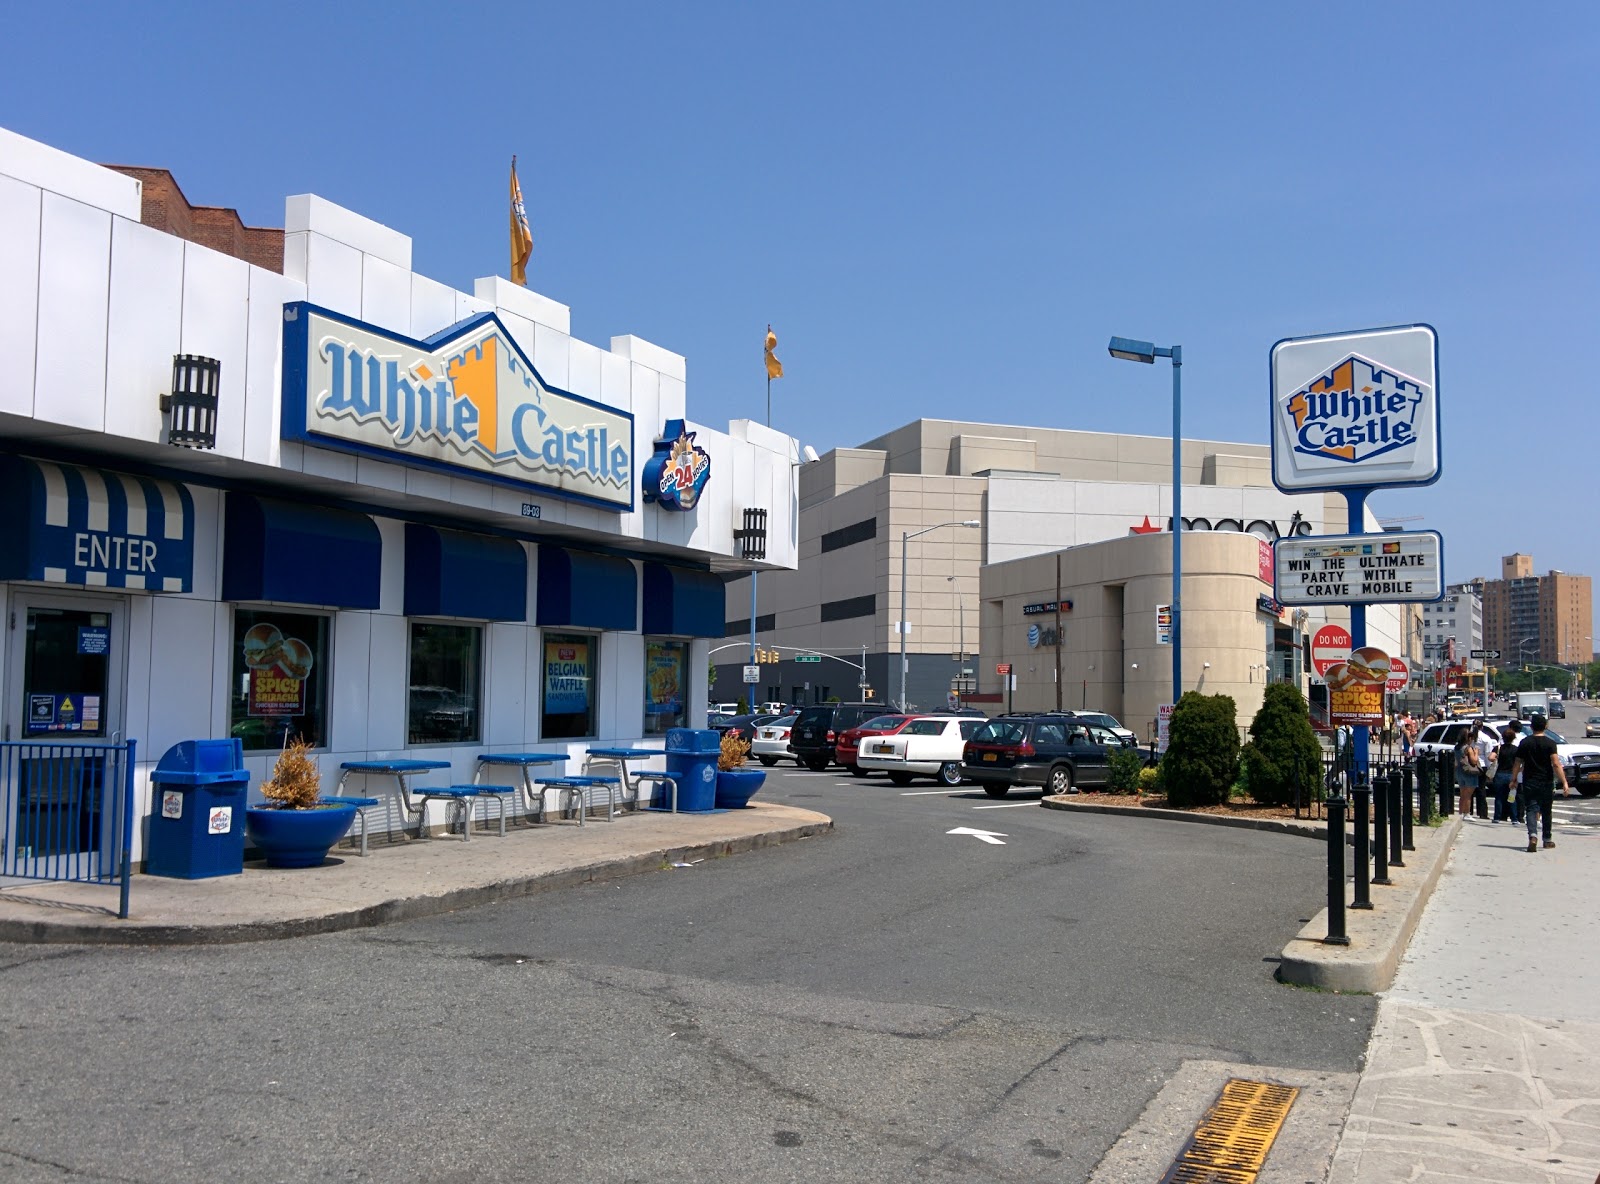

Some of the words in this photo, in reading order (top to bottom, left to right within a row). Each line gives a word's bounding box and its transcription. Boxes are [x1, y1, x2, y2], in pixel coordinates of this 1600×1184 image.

[322, 342, 479, 443] White
[511, 403, 629, 483] Castle
[1304, 390, 1407, 422] White
[1298, 416, 1412, 449] Castle
[660, 472, 675, 491] OPEN
[674, 464, 694, 488] 24
[692, 455, 708, 480] HOURS
[523, 504, 540, 518] 89-03
[75, 533, 157, 573] ENTER
[1288, 560, 1311, 571] WIN
[1322, 558, 1345, 569] THE
[1359, 554, 1425, 568] ULTIMATE
[1301, 571, 1344, 583] PARTY
[1364, 569, 1396, 581] WITH
[1306, 584, 1349, 596] CRAVE
[1362, 582, 1413, 594] MOBILE
[1319, 635, 1330, 645] DO
[1332, 635, 1348, 645] NOT
[256, 670, 274, 678] NEW
[548, 663, 585, 676] BELGIAN
[255, 677, 300, 694] SPICY
[550, 677, 583, 690] WAFFLE
[255, 693, 300, 703] SRIRACHA
[548, 692, 585, 701] SANDWICHES
[1331, 691, 1382, 705] SPICY
[1331, 704, 1382, 713] SRIRACHA
